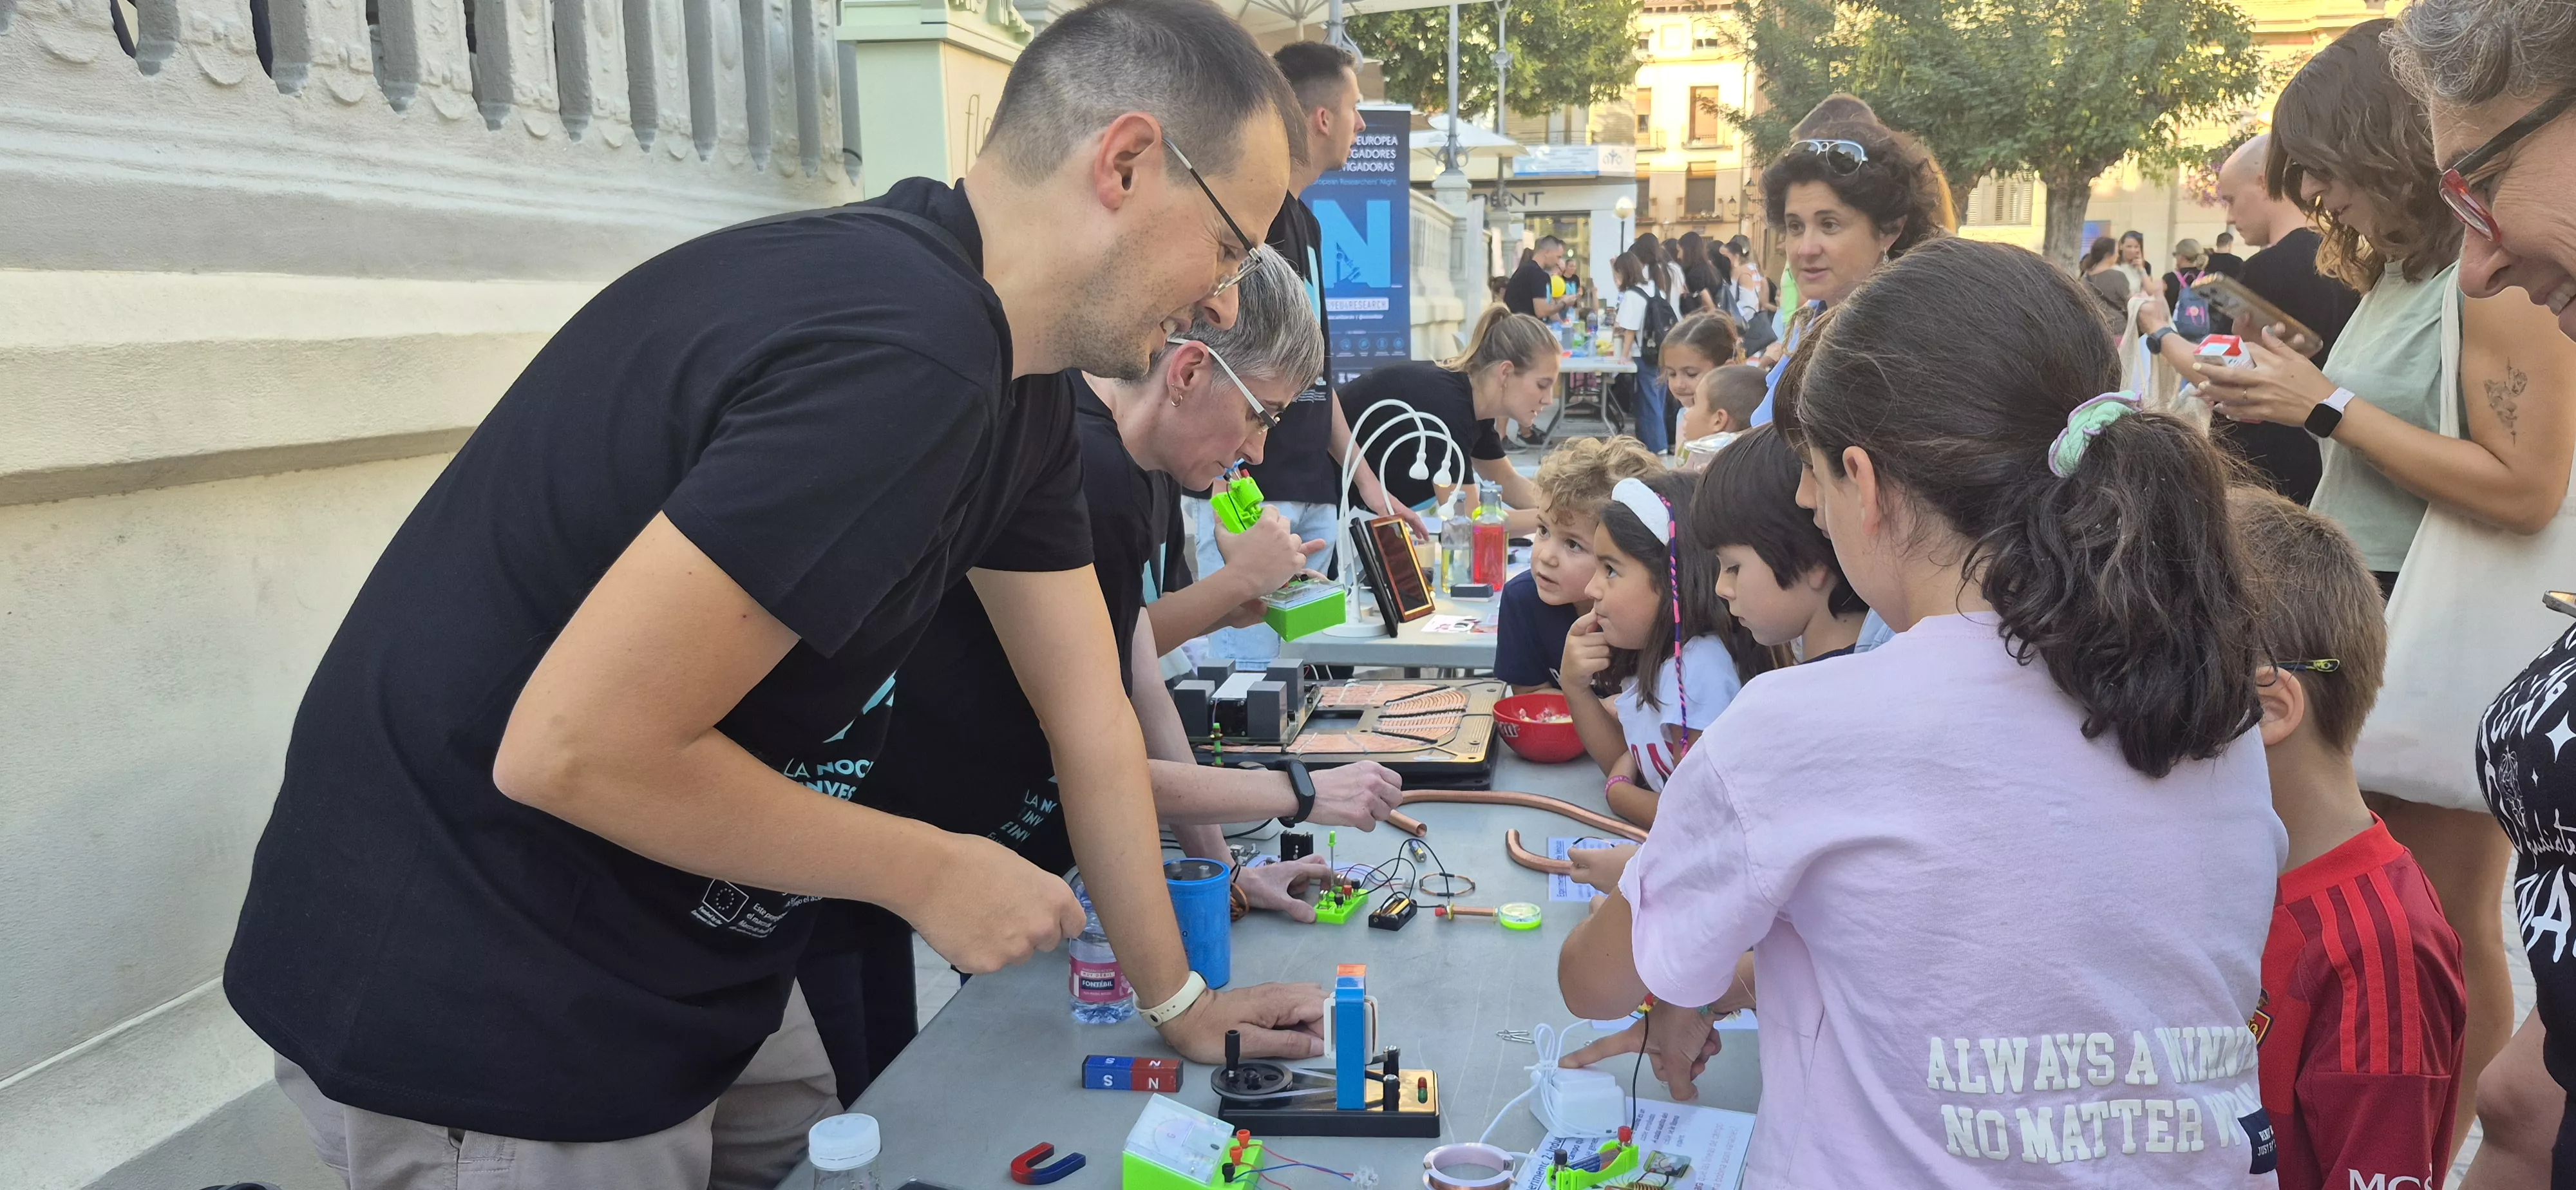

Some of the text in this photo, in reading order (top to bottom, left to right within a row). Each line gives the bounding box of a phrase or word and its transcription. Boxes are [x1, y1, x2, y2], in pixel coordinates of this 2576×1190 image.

[1356, 135, 1398, 146] EUROPEA
[1349, 149, 1396, 159] GADORES
[783, 757, 874, 779] LA NOC
[1025, 789, 1038, 808] LA
[1927, 1032, 2115, 1094] ALWAYS
[2125, 1030, 2158, 1086] A
[1103, 1075, 1159, 1089] S N
[1941, 1104, 2010, 1160] NO
[2016, 1098, 2204, 1164] MATTER
